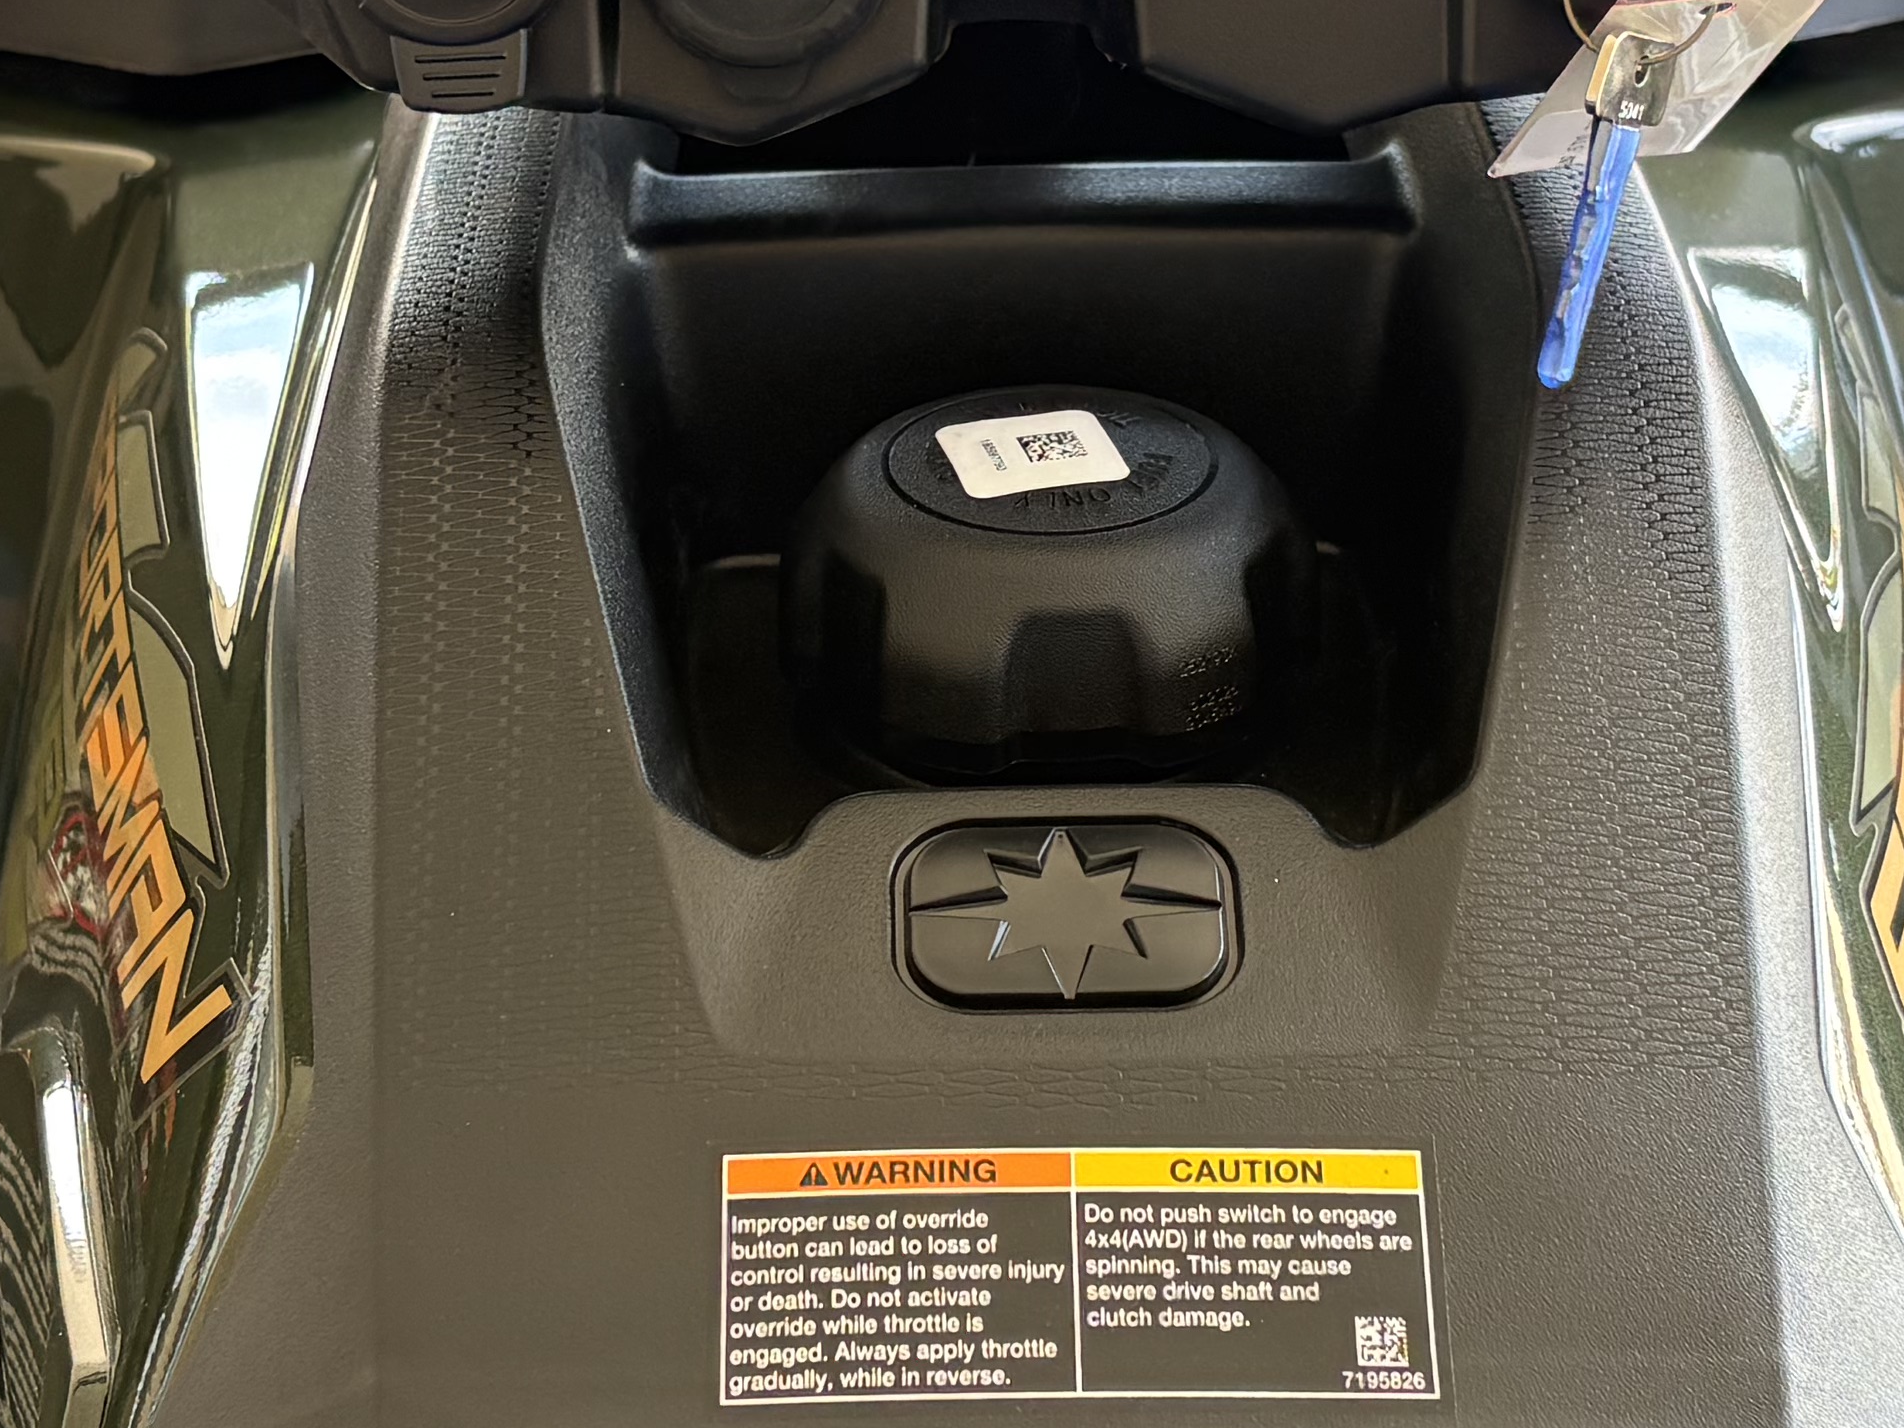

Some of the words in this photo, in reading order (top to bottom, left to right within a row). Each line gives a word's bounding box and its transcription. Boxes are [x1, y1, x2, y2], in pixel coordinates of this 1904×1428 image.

[834, 1159, 997, 1185] WARNING
[1169, 1159, 1324, 1184] CAUTION
[731, 1215, 826, 1237] Improper
[833, 1213, 869, 1231] use
[876, 1210, 896, 1229] of
[902, 1209, 989, 1229] override
[1084, 1203, 1114, 1223] Do
[1120, 1206, 1154, 1223] not
[1161, 1204, 1212, 1226] push
[1218, 1204, 1286, 1223] switch
[1293, 1205, 1313, 1224] to
[1319, 1208, 1397, 1229] engage
[731, 1239, 798, 1260] button
[805, 1240, 843, 1258] can
[850, 1236, 894, 1255] lead
[901, 1238, 922, 1255] to
[928, 1234, 970, 1254] loss
[977, 1234, 997, 1253] of
[1085, 1228, 1188, 1253] 4x4(AWD)
[1194, 1230, 1207, 1249] if
[1213, 1230, 1246, 1249] the
[1252, 1234, 1293, 1250] rear
[1300, 1231, 1374, 1251] wheels
[1379, 1235, 1413, 1251] are
[731, 1265, 804, 1286] control
[810, 1263, 901, 1284] resulting
[908, 1261, 926, 1280] in
[933, 1261, 1002, 1280] severe
[1008, 1260, 1065, 1283] injury
[1086, 1256, 1181, 1280] spinning.
[1187, 1254, 1232, 1274] This
[1238, 1258, 1282, 1280] may
[1288, 1258, 1351, 1276] cause
[730, 1296, 752, 1313] or
[758, 1289, 824, 1310] death.
[831, 1288, 861, 1308] Do
[867, 1288, 901, 1307] not
[908, 1287, 991, 1306] activate
[1086, 1283, 1156, 1301] severe
[1163, 1280, 1215, 1301] drive
[1222, 1280, 1274, 1301] shaft
[1280, 1282, 1320, 1302] and
[730, 1316, 816, 1339] override
[823, 1314, 877, 1335] while
[884, 1314, 959, 1333] throttle
[966, 1313, 983, 1333] is
[1087, 1308, 1152, 1328] clutch
[1159, 1308, 1251, 1331] damage.
[730, 1342, 828, 1368] engaged.
[835, 1341, 910, 1364] Always
[917, 1340, 975, 1364] apply
[981, 1338, 1058, 1360] throttle
[729, 1368, 833, 1396] gradually,
[840, 1367, 895, 1388] while
[902, 1366, 920, 1386] in
[927, 1368, 1010, 1386] reverse.
[1342, 1371, 1426, 1391] 7195826
